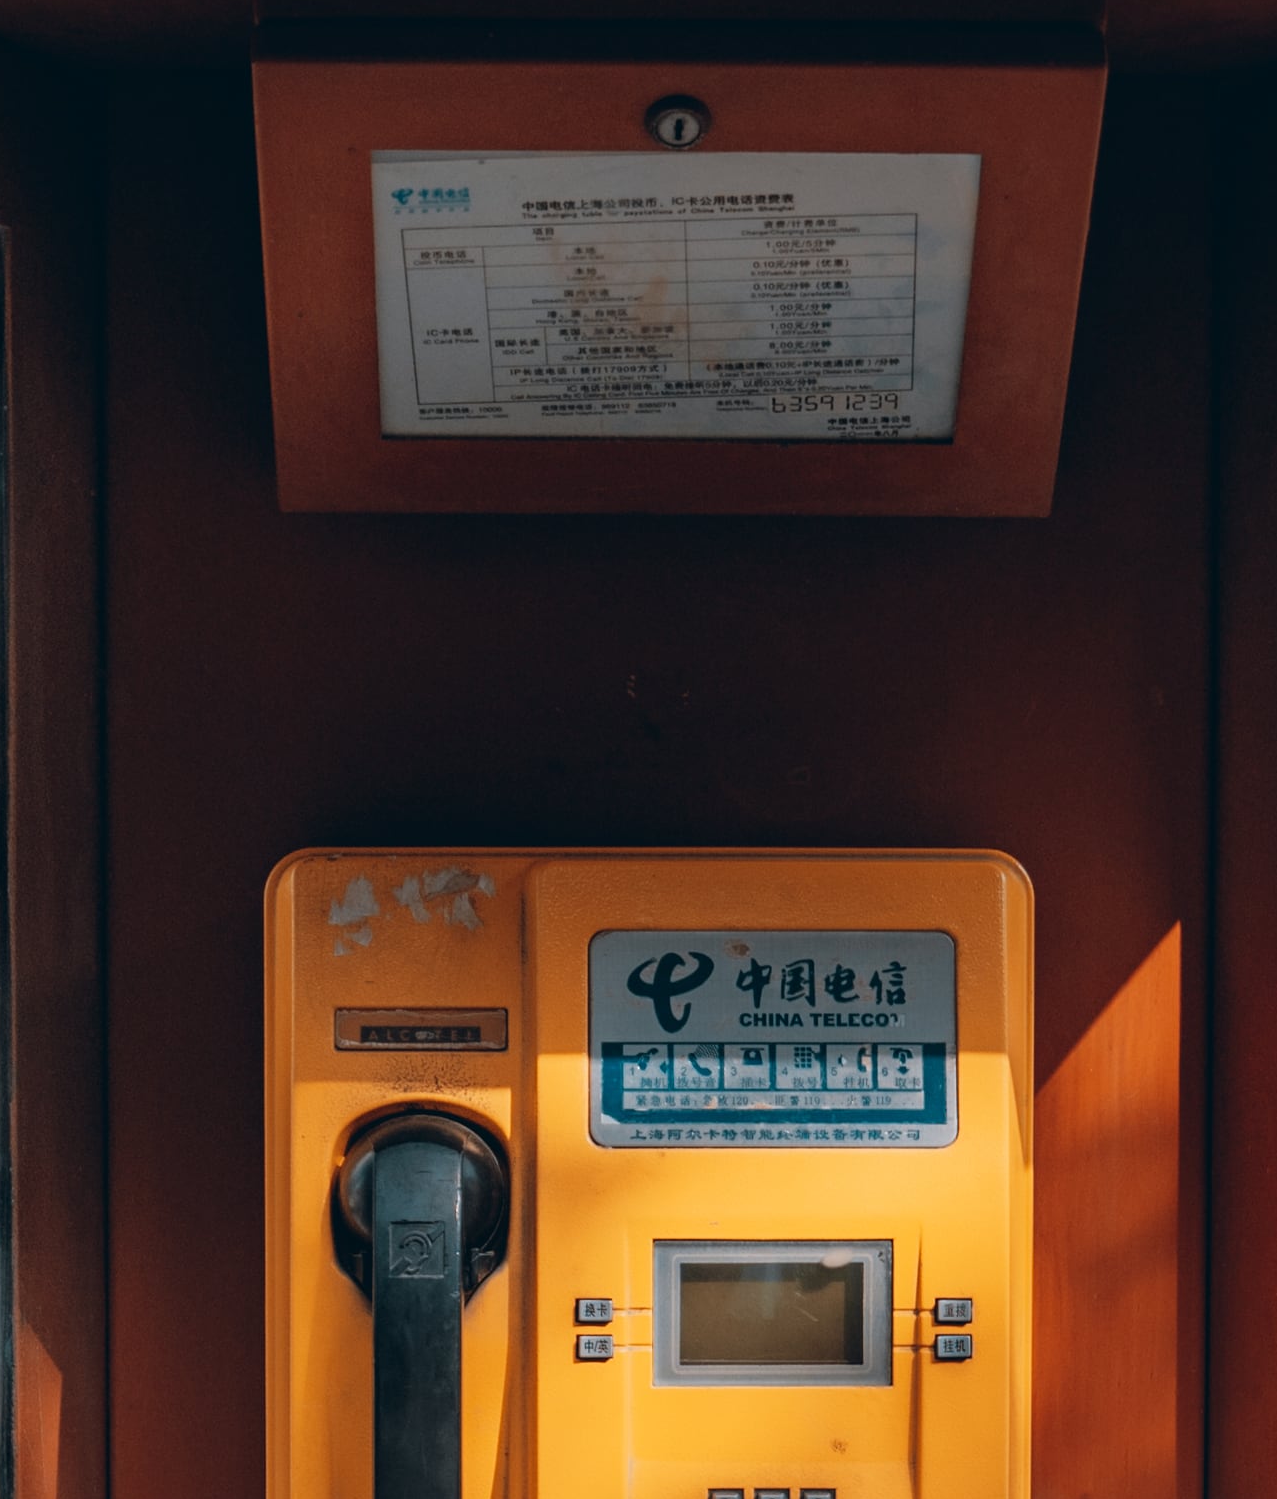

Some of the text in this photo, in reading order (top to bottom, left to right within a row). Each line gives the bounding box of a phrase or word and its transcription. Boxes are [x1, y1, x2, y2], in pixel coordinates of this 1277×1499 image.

[736, 958, 907, 1009] 中国电信
[739, 1012, 803, 1027] CHINA
[369, 1029, 476, 1041] ALCTEL
[730, 1066, 738, 1076] 3
[781, 1067, 789, 1076] 4
[830, 1066, 838, 1076] 5
[881, 1066, 889, 1077] 6
[629, 1128, 921, 1142] 上海阿尔卡特智能终端设备有限公司
[584, 1339, 609, 1354] 中/英
[943, 1339, 967, 1354] 挂机
